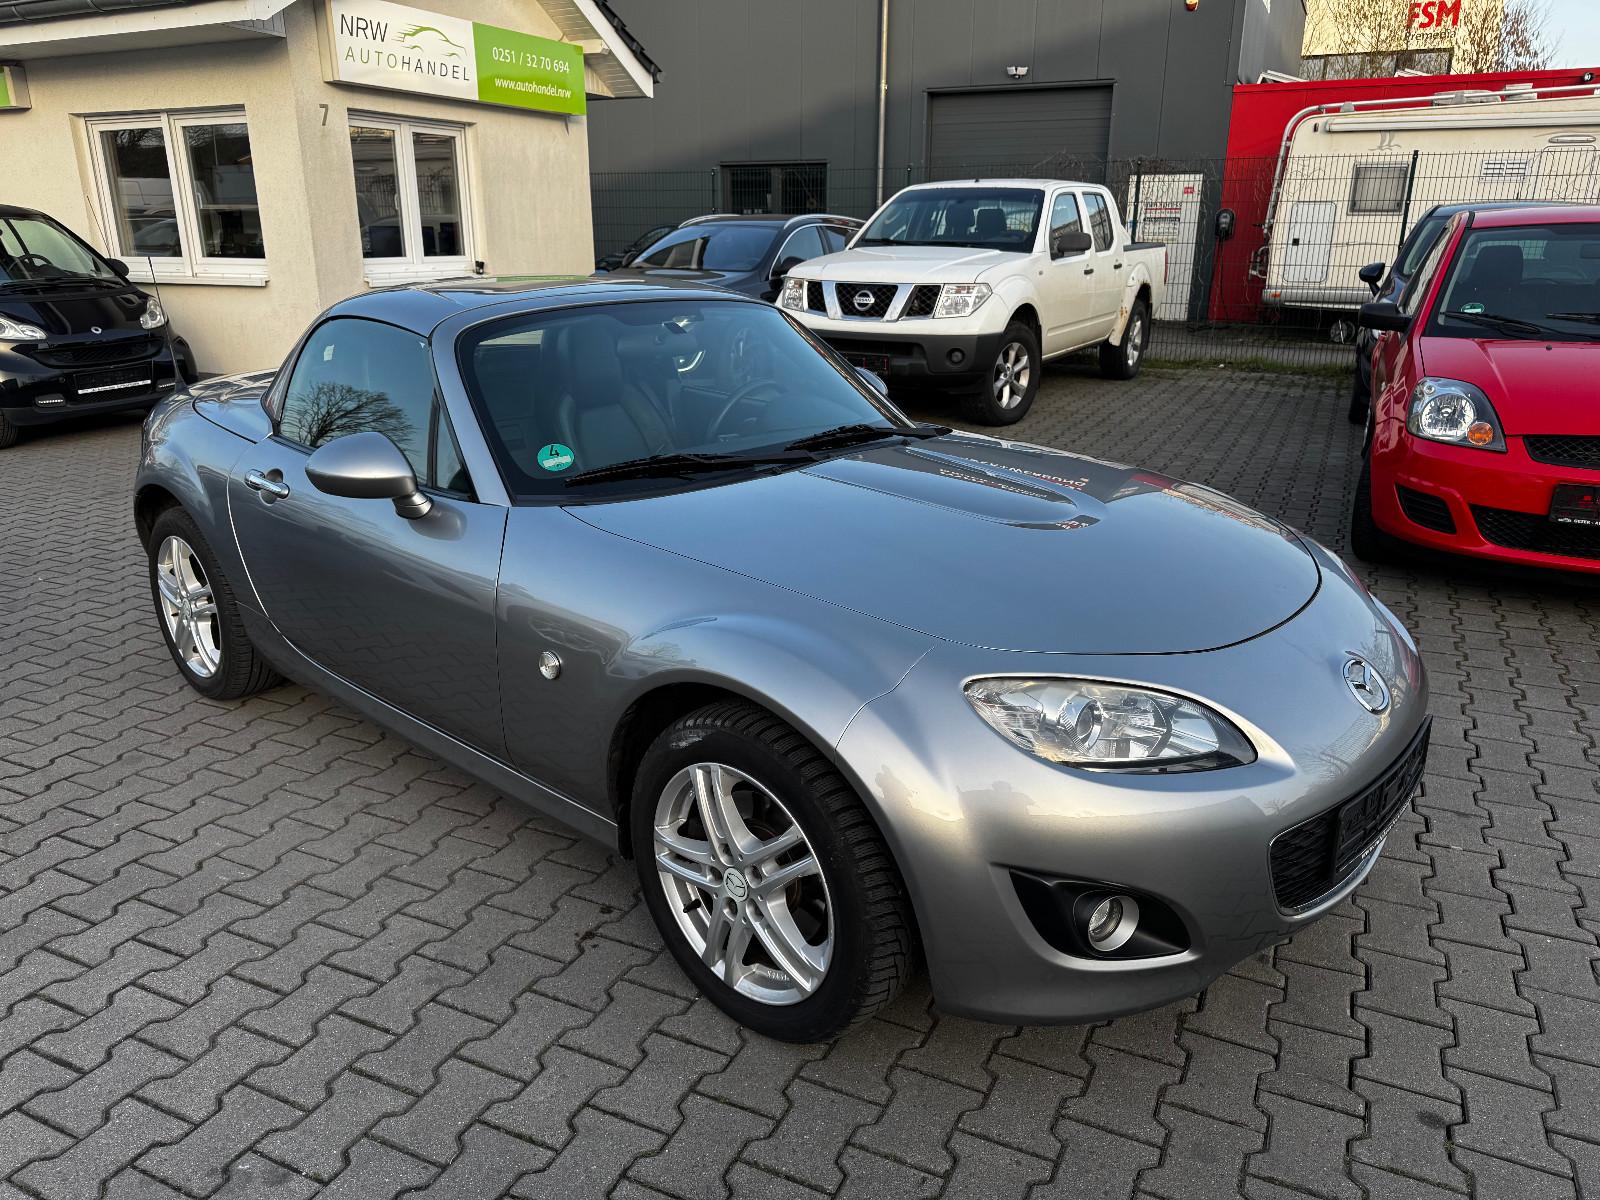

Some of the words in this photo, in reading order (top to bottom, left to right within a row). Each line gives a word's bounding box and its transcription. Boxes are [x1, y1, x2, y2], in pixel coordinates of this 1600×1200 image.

[1407, 0, 1461, 28] FSM
[341, 14, 388, 42] NRW
[345, 46, 470, 81] AUTOHANDEL
[492, 47, 515, 63] 0251
[519, 51, 524, 65] /
[526, 53, 538, 68] 32
[540, 56, 551, 71] 70
[553, 60, 570, 74] 694
[494, 77, 572, 98] www.autohandel.nrw
[319, 103, 329, 126] 7
[550, 444, 560, 457] 4
